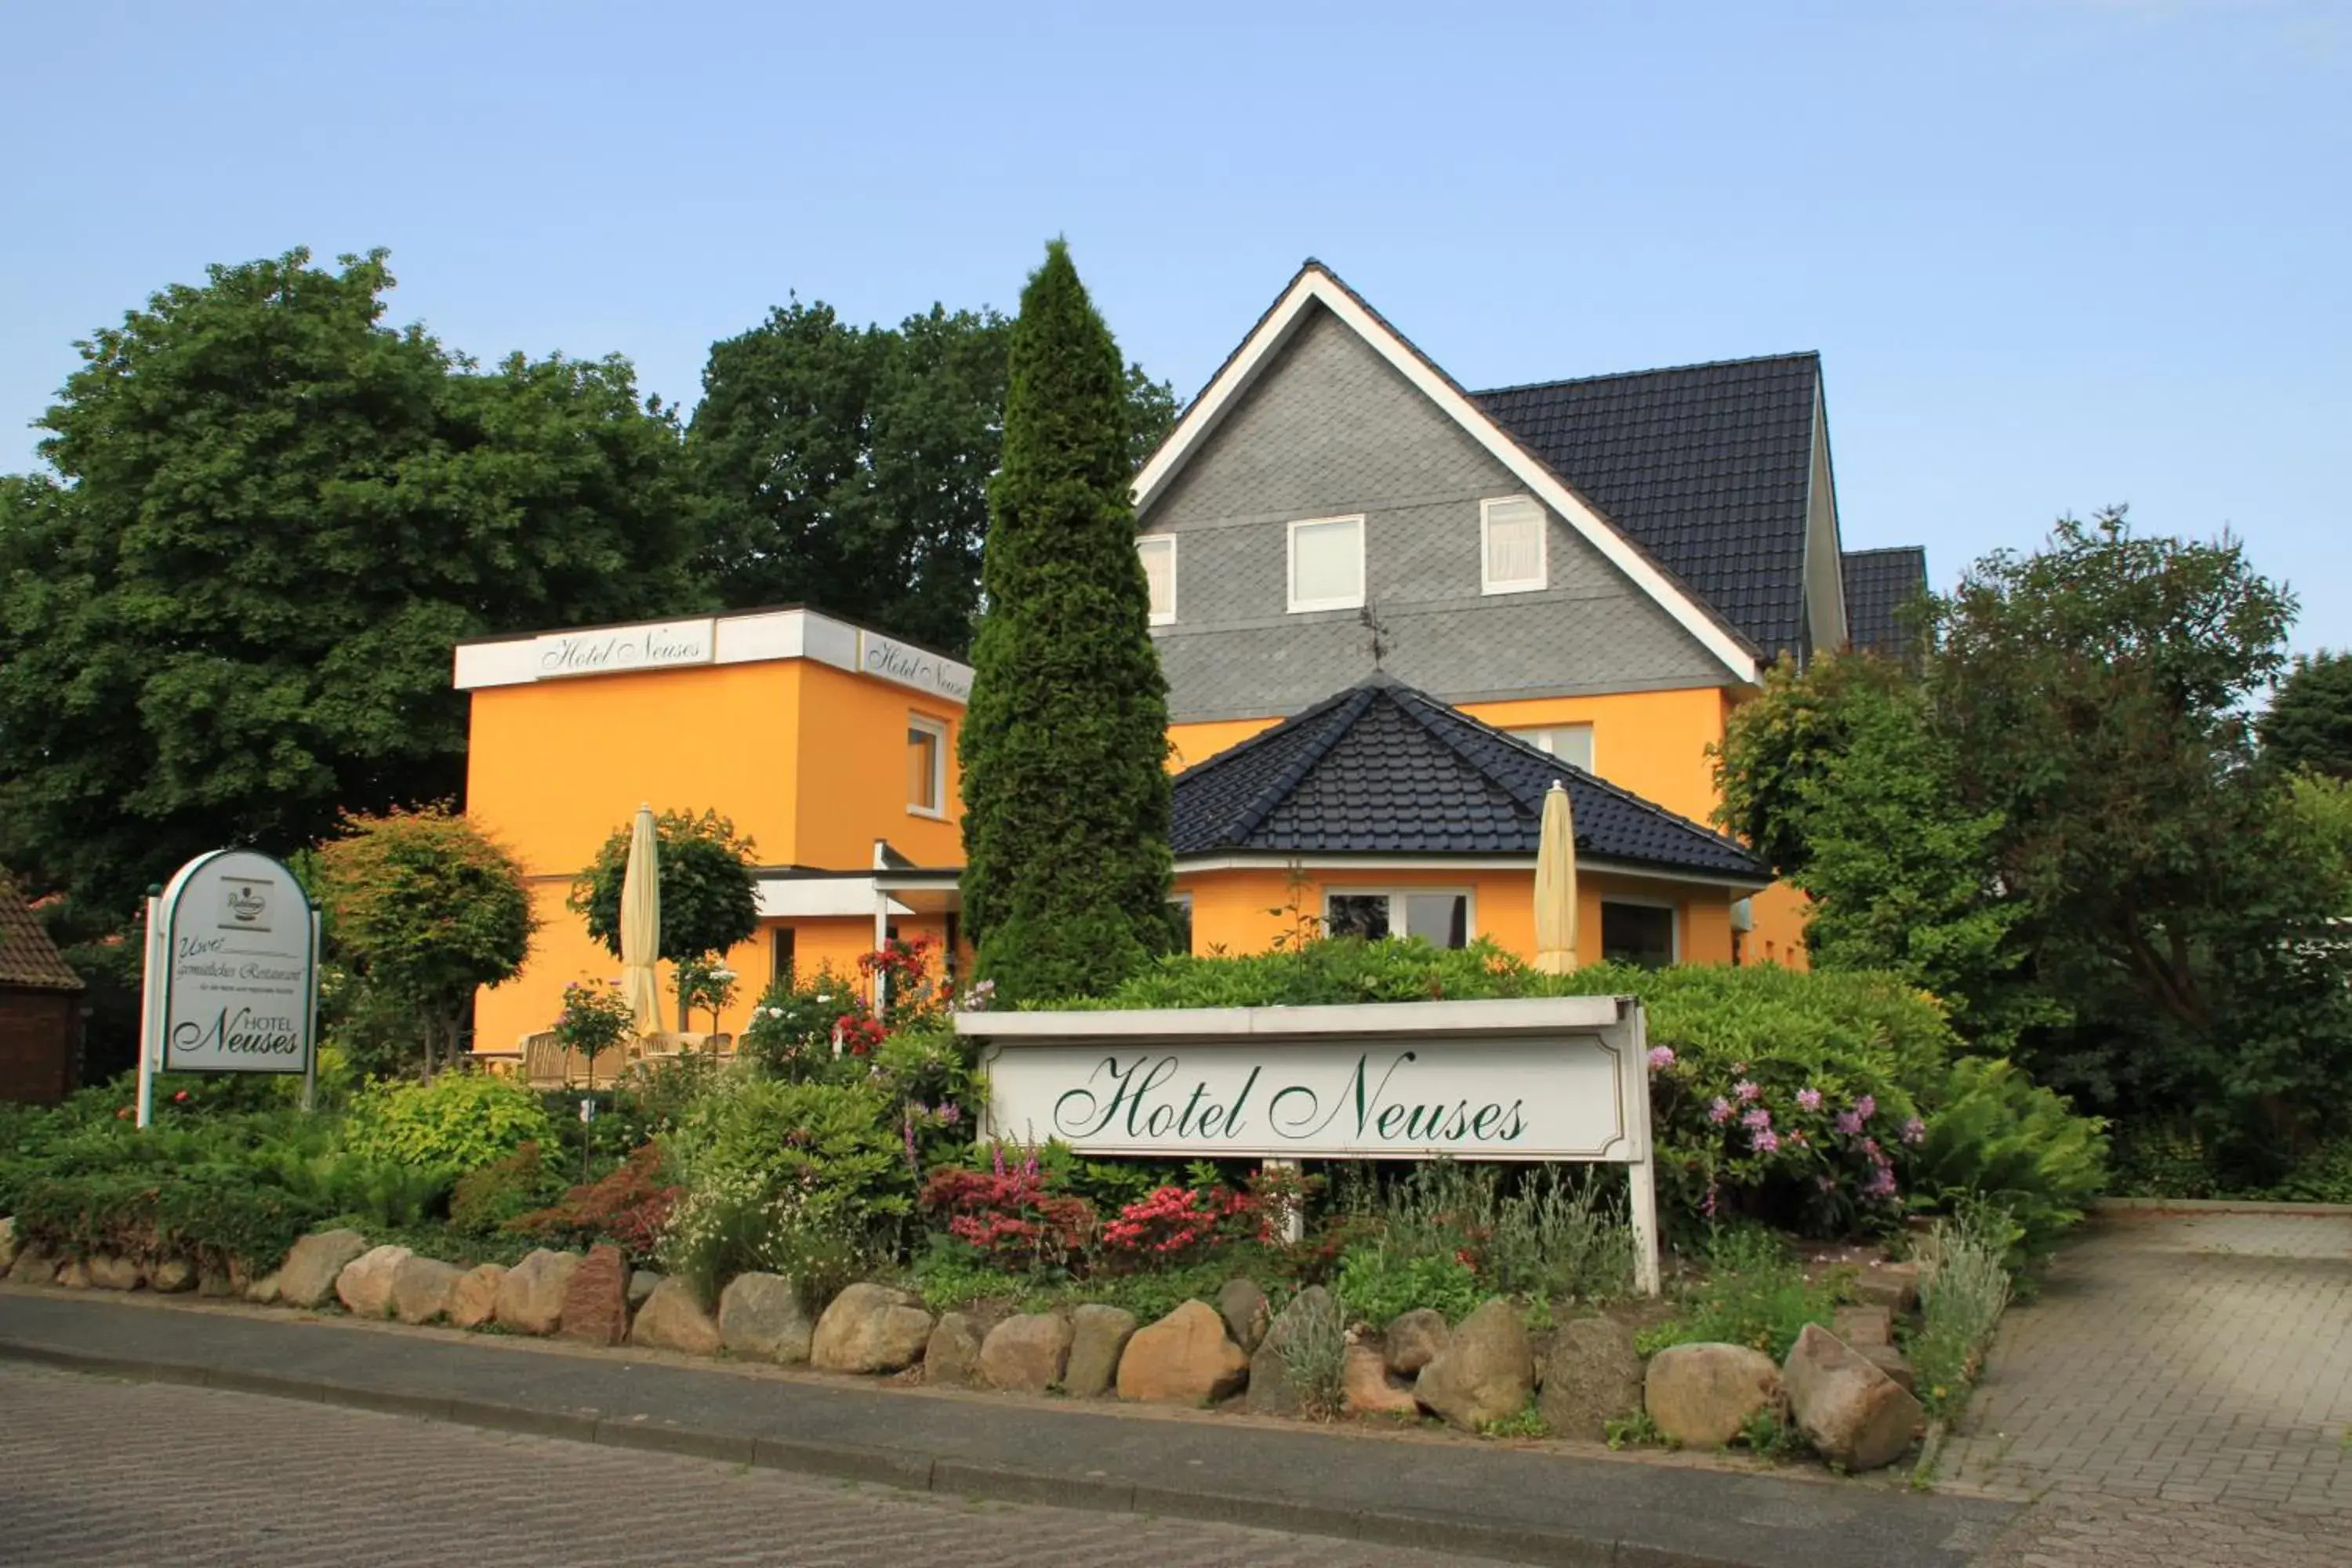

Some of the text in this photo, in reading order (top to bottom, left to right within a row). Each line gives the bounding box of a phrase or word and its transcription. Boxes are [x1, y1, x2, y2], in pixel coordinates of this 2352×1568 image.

[540, 628, 699, 670] Hotel Neuses
[868, 641, 920, 681] Hotel
[172, 1007, 298, 1054] Neuses
[244, 1016, 294, 1032] HOTEL
[1054, 1050, 1529, 1142] Hotel Neuses
